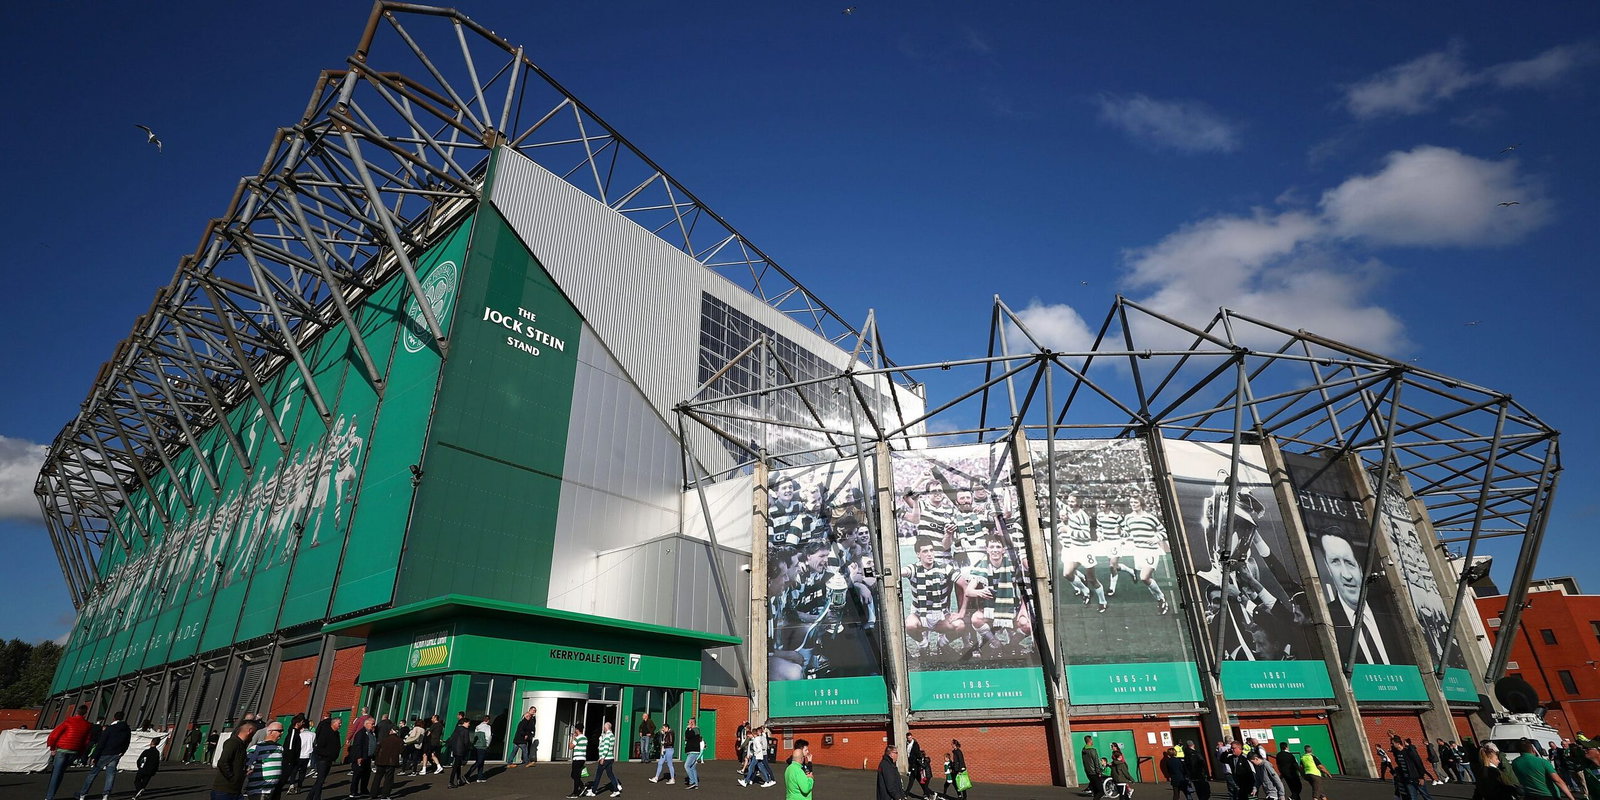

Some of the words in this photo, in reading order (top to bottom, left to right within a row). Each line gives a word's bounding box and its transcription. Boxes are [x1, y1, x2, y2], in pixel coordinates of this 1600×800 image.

[517, 307, 537, 322] THE
[482, 306, 523, 334] JOCK
[525, 326, 565, 352] STEIN
[506, 336, 540, 357] STAND
[549, 649, 601, 663] KERRYDALE
[602, 654, 626, 666] SUITE
[630, 657, 640, 671] 7
[1109, 674, 1158, 683] 1965-74
[1263, 671, 1287, 679] 1967
[962, 680, 991, 689] 1985
